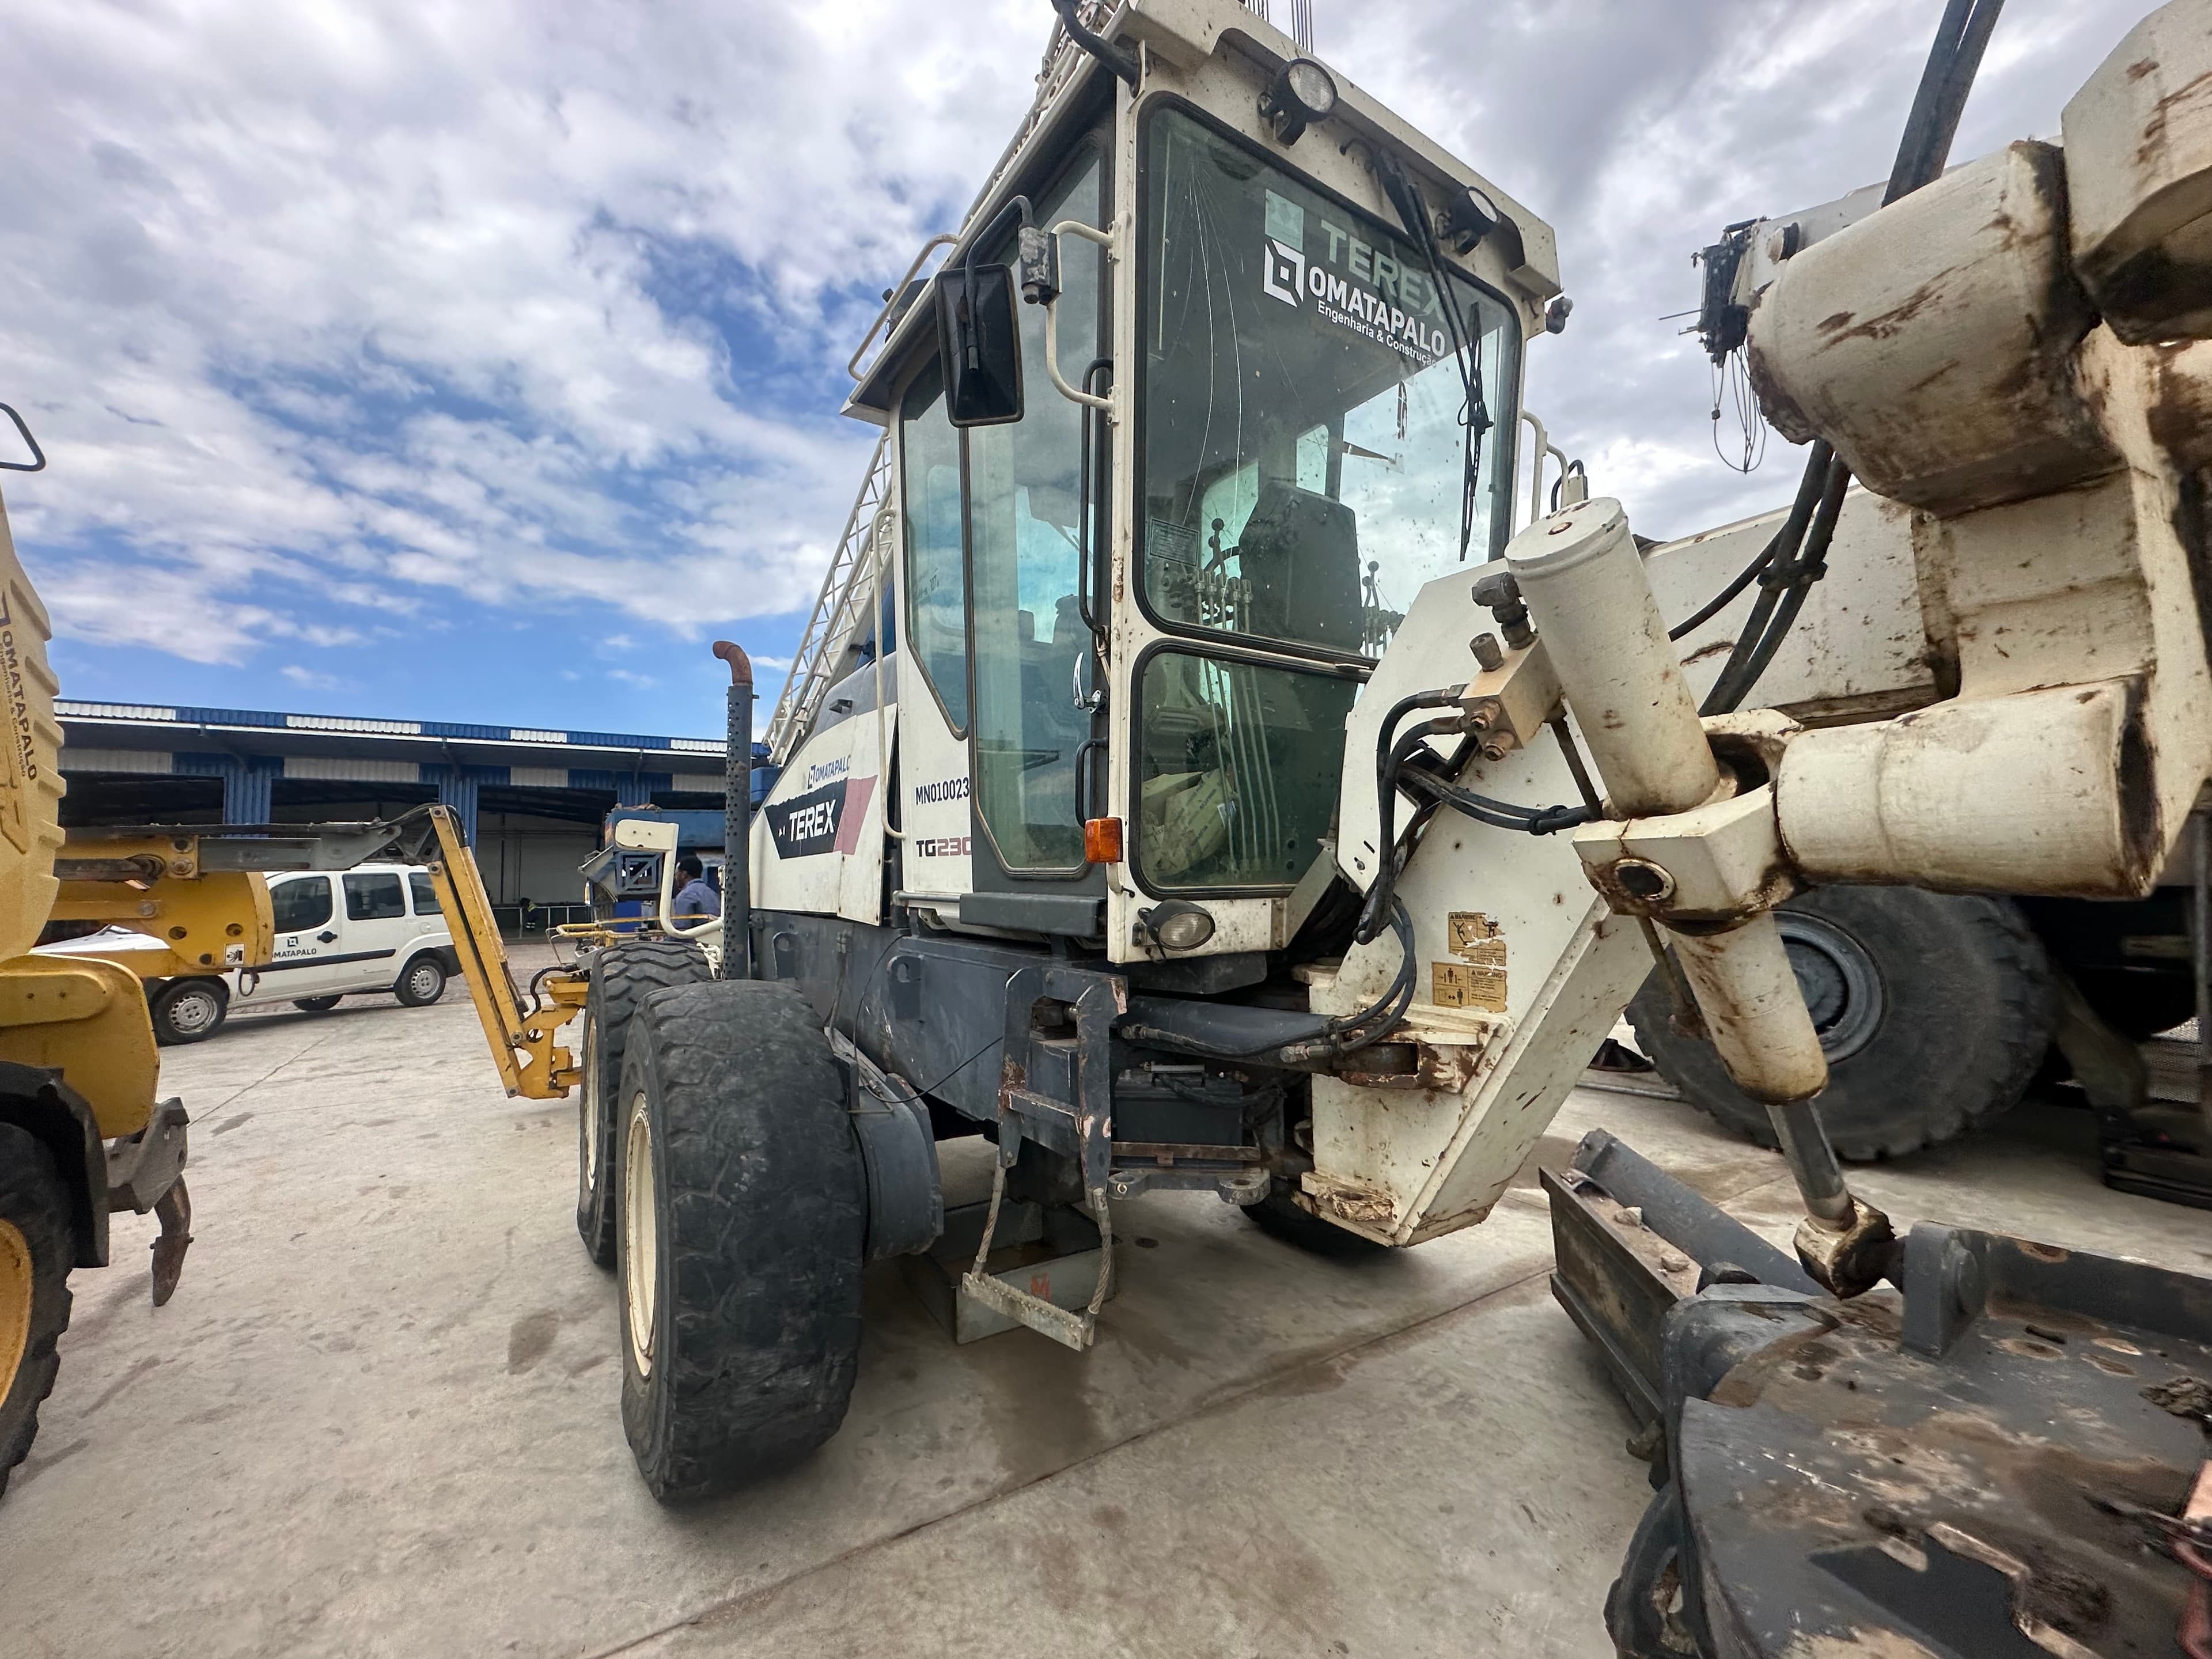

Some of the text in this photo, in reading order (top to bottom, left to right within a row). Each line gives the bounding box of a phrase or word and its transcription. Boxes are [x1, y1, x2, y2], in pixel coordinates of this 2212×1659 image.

[1321, 219, 1445, 323] TEREX
[1308, 266, 1445, 357] OMATAPALO
[1317, 299, 1437, 369] Engenharia & Construção
[2, 630, 37, 781] OMATAPALO
[789, 799, 836, 842] TEREX
[915, 777, 969, 805] MN010023
[272, 948, 317, 959] MATAPALO
